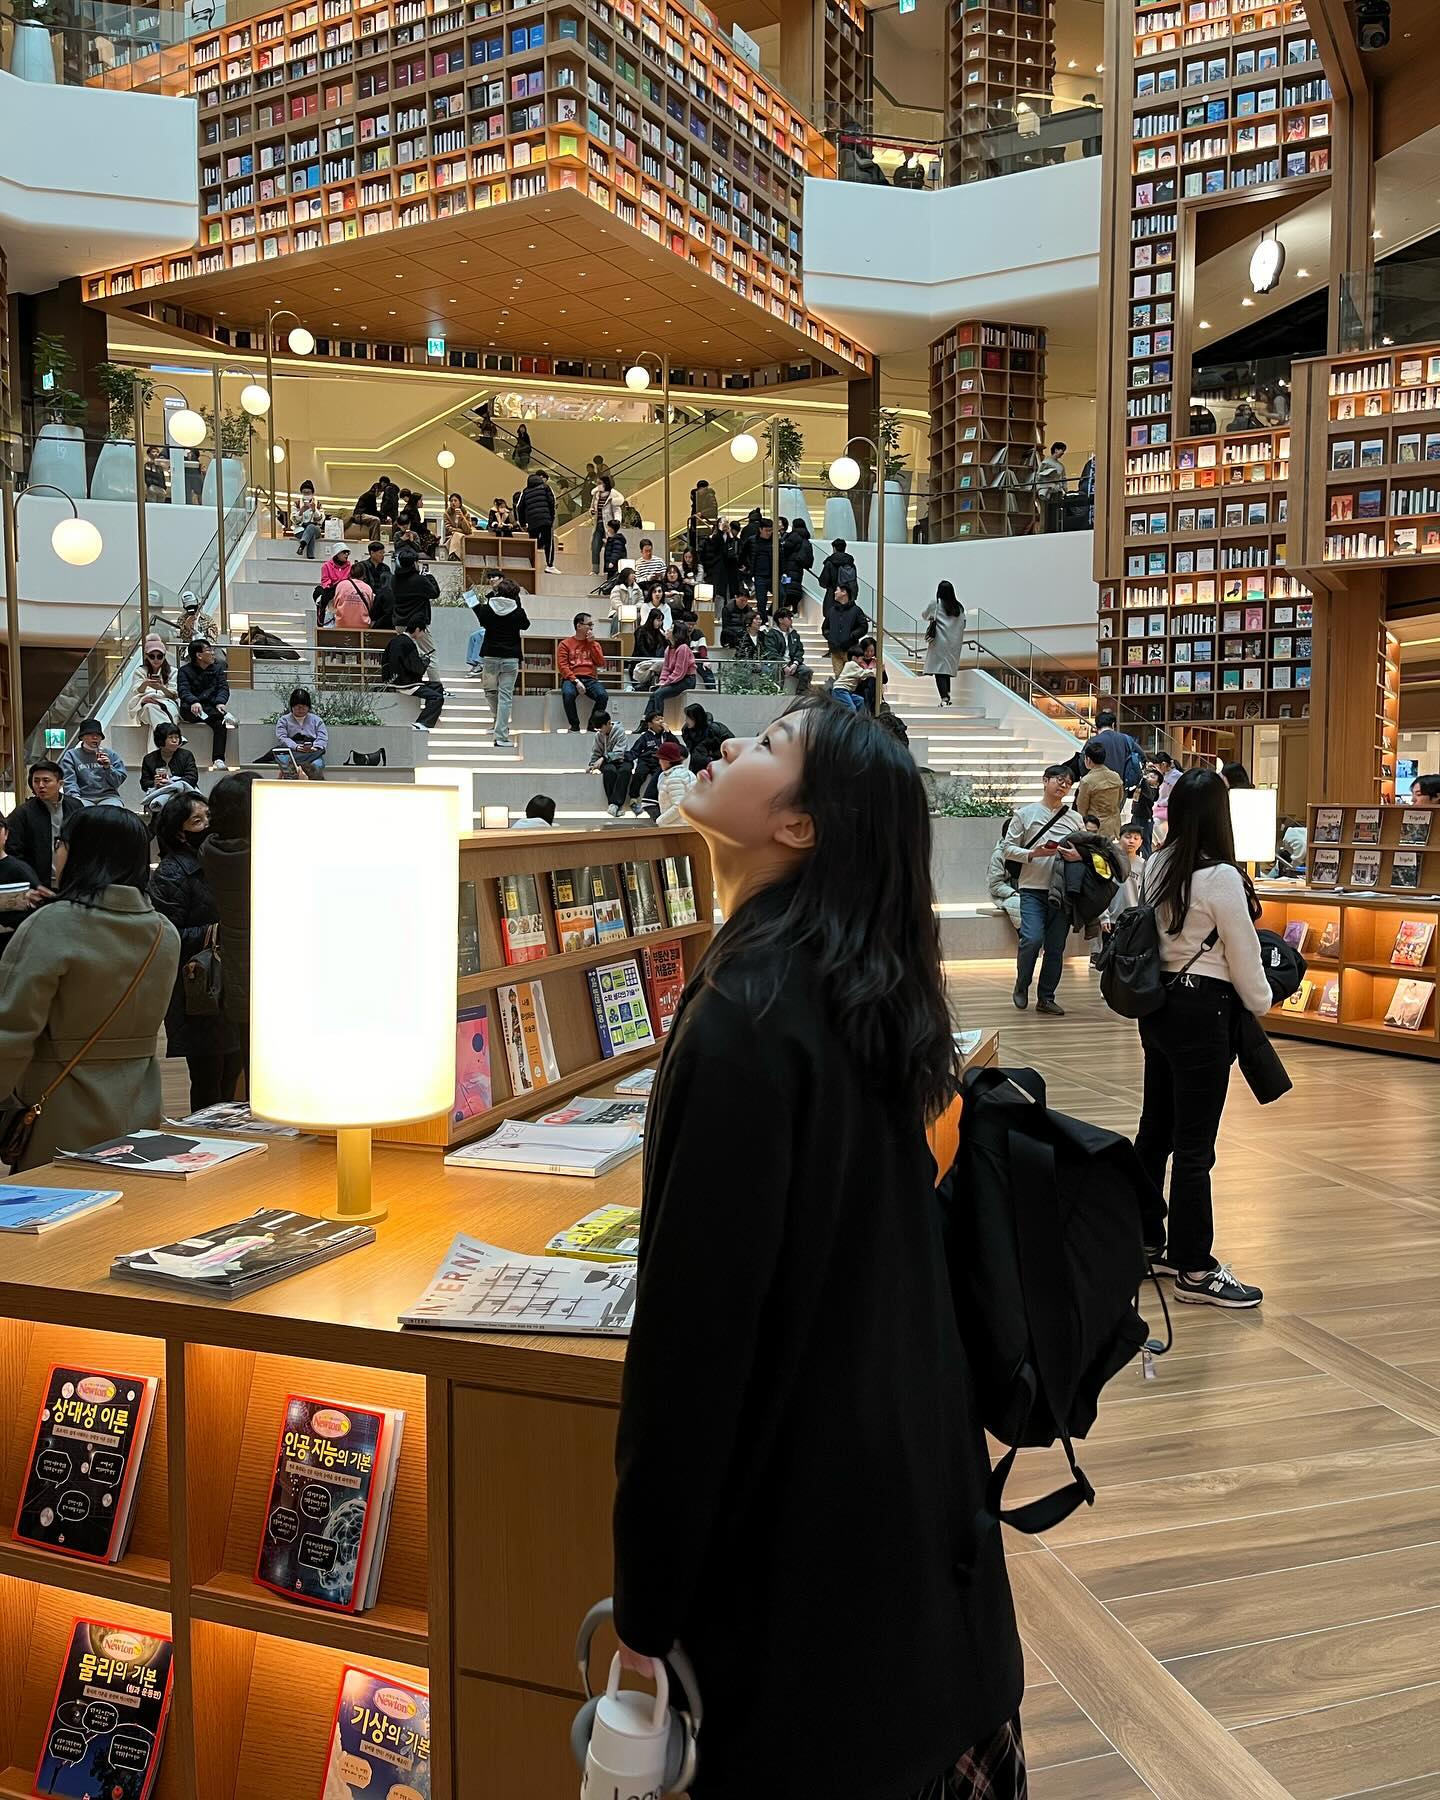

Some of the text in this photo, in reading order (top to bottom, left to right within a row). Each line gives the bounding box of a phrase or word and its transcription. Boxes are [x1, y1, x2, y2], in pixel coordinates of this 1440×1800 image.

[52, 1398, 129, 1435] 상대성 이론
[285, 1432, 371, 1473] 인공 지능의 기본
[103, 1639, 134, 1655] Newton
[79, 1653, 157, 1689] 물리의 기본
[376, 1693, 408, 1714] Newton
[350, 1705, 401, 1746] 기상의
[405, 1731, 430, 1760] 기본
